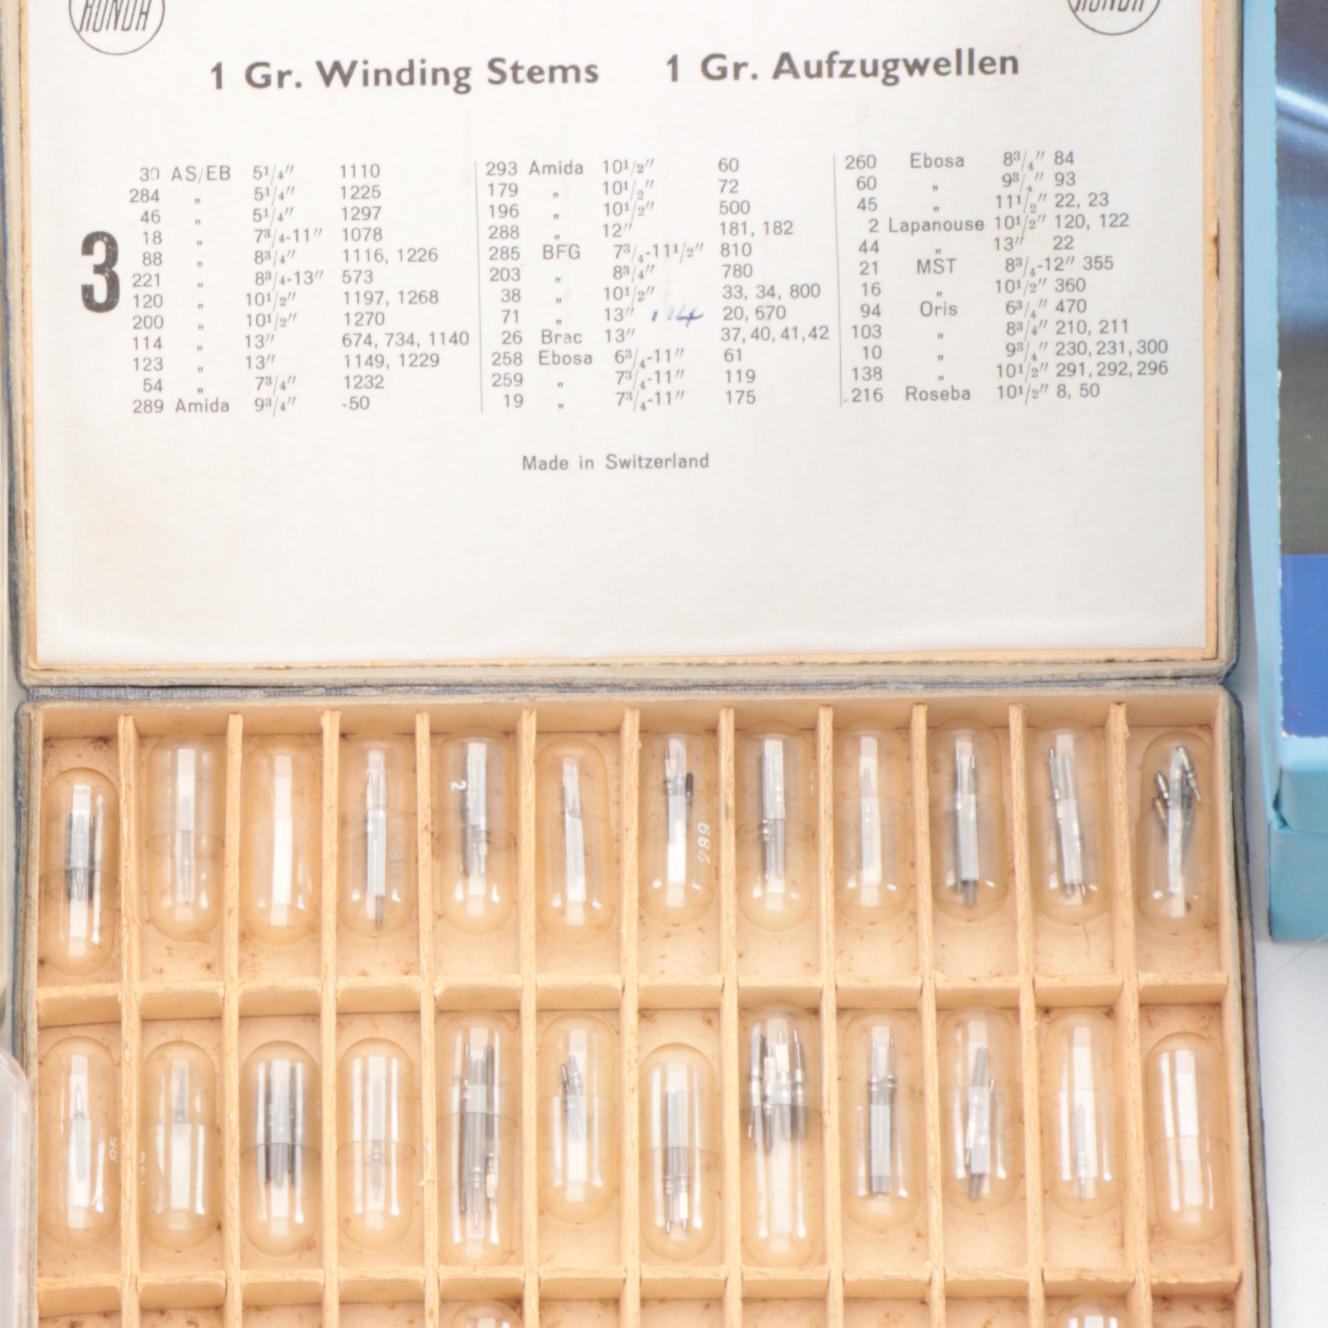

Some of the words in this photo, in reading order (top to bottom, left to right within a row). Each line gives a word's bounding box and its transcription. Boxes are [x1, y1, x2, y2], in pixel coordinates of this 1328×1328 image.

[211, 62, 222, 90] 1
[245, 61, 302, 89] Gr.
[315, 58, 472, 95] Winding
[487, 57, 599, 85] Stems
[667, 54, 678, 82] 1
[701, 53, 758, 81] Gr.
[772, 48, 1018, 87] Aufzugwellen
[486, 162, 517, 176] 293
[529, 160, 583, 175] Amida
[718, 158, 739, 172] 60
[846, 155, 876, 169] 260
[910, 153, 964, 168] Ebosa
[1054, 151, 1074, 165] 84
[172, 165, 230, 181] AS/EB
[341, 164, 380, 178] 1110
[857, 176, 877, 190] 60
[1055, 172, 1075, 186] 93
[130, 189, 159, 203] 284
[342, 185, 381, 199] 1225
[489, 183, 518, 197] 179
[720, 179, 738, 193] 72
[490, 204, 519, 218] 196
[720, 200, 750, 215] 500
[857, 197, 877, 211] 45
[1055, 193, 1080, 208] 22,
[1089, 192, 1109, 207] 23
[141, 210, 160, 223] 46
[342, 206, 381, 220] 1297
[489, 225, 519, 239] 288
[720, 221, 754, 237] 181,
[764, 220, 793, 235] 182
[869, 218, 878, 233] 2
[889, 217, 984, 236] Lapanouse
[1056, 214, 1090, 230] 120,
[1100, 213, 1129, 227] 122
[144, 231, 162, 244] 18
[343, 227, 382, 241] 1078
[859, 240, 879, 254] 44
[1053, 235, 1073, 250] 22
[143, 252, 162, 266] 88
[344, 249, 388, 264] 1116,
[398, 248, 438, 262] 1226
[489, 246, 520, 261] 285
[543, 244, 580, 260] BFG
[721, 242, 752, 257] 810
[81, 231, 120, 313] 3
[490, 267, 520, 281] 203
[723, 264, 752, 278] 780
[860, 261, 877, 275] 21
[917, 258, 956, 274] MST
[1083, 256, 1113, 270] 355
[133, 273, 159, 287] 221
[343, 270, 373, 284] 573
[862, 282, 881, 296] 16
[1055, 278, 1086, 292] 360
[134, 294, 163, 308] 120
[344, 291, 389, 306] 1197,
[399, 290, 438, 304] 1268
[501, 289, 521, 303] 38
[723, 285, 747, 300] 33,
[756, 285, 781, 300] 34,
[790, 283, 820, 298] 800
[502, 310, 518, 323] 71
[723, 306, 748, 321] 20,
[755, 305, 786, 320] 670
[861, 304, 881, 318] 94
[920, 301, 957, 317] Oris
[1056, 299, 1087, 313] 470
[133, 315, 164, 329] 200
[345, 312, 385, 326] 1270
[852, 324, 882, 339] 103
[1056, 320, 1091, 336] 210,
[1100, 319, 1127, 334] 211
[134, 336, 162, 350] 114
[342, 333, 377, 348] 674,
[386, 332, 420, 347] 734,
[430, 331, 469, 345] 1140
[502, 330, 522, 345] 26
[542, 329, 582, 344] Brac
[721, 327, 745, 343] 37,
[750, 326, 775, 342] 40,
[781, 326, 805, 342] 41,
[808, 325, 828, 339] 42
[492, 352, 523, 366] 258
[539, 350, 592, 365] Ebosa
[724, 348, 741, 362] 61
[863, 345, 882, 359] 10
[1056, 341, 1091, 356] 230,
[1097, 340, 1132, 356] 231,
[1137, 339, 1168, 354] 300
[134, 357, 163, 371] 123
[346, 354, 389, 369] 1149,
[400, 353, 439, 367] 1229
[853, 367, 882, 381] 138
[1056, 362, 1092, 378] 291,
[1097, 361, 1132, 377] 292,
[1137, 360, 1168, 375] 296
[144, 378, 162, 392] 54
[345, 375, 384, 389] 1232
[492, 373, 523, 387] 259
[726, 369, 756, 383] 119
[505, 394, 523, 408] 19
[726, 390, 756, 404] 175
[852, 388, 883, 402] 216
[906, 385, 970, 401] Roseba
[1057, 384, 1071, 399] 8,
[1080, 383, 1100, 397] 50
[133, 399, 164, 413] 289
[176, 398, 229, 412] Amida
[523, 455, 568, 470] Made
[580, 456, 594, 469] in
[606, 453, 708, 469] Switzerland
